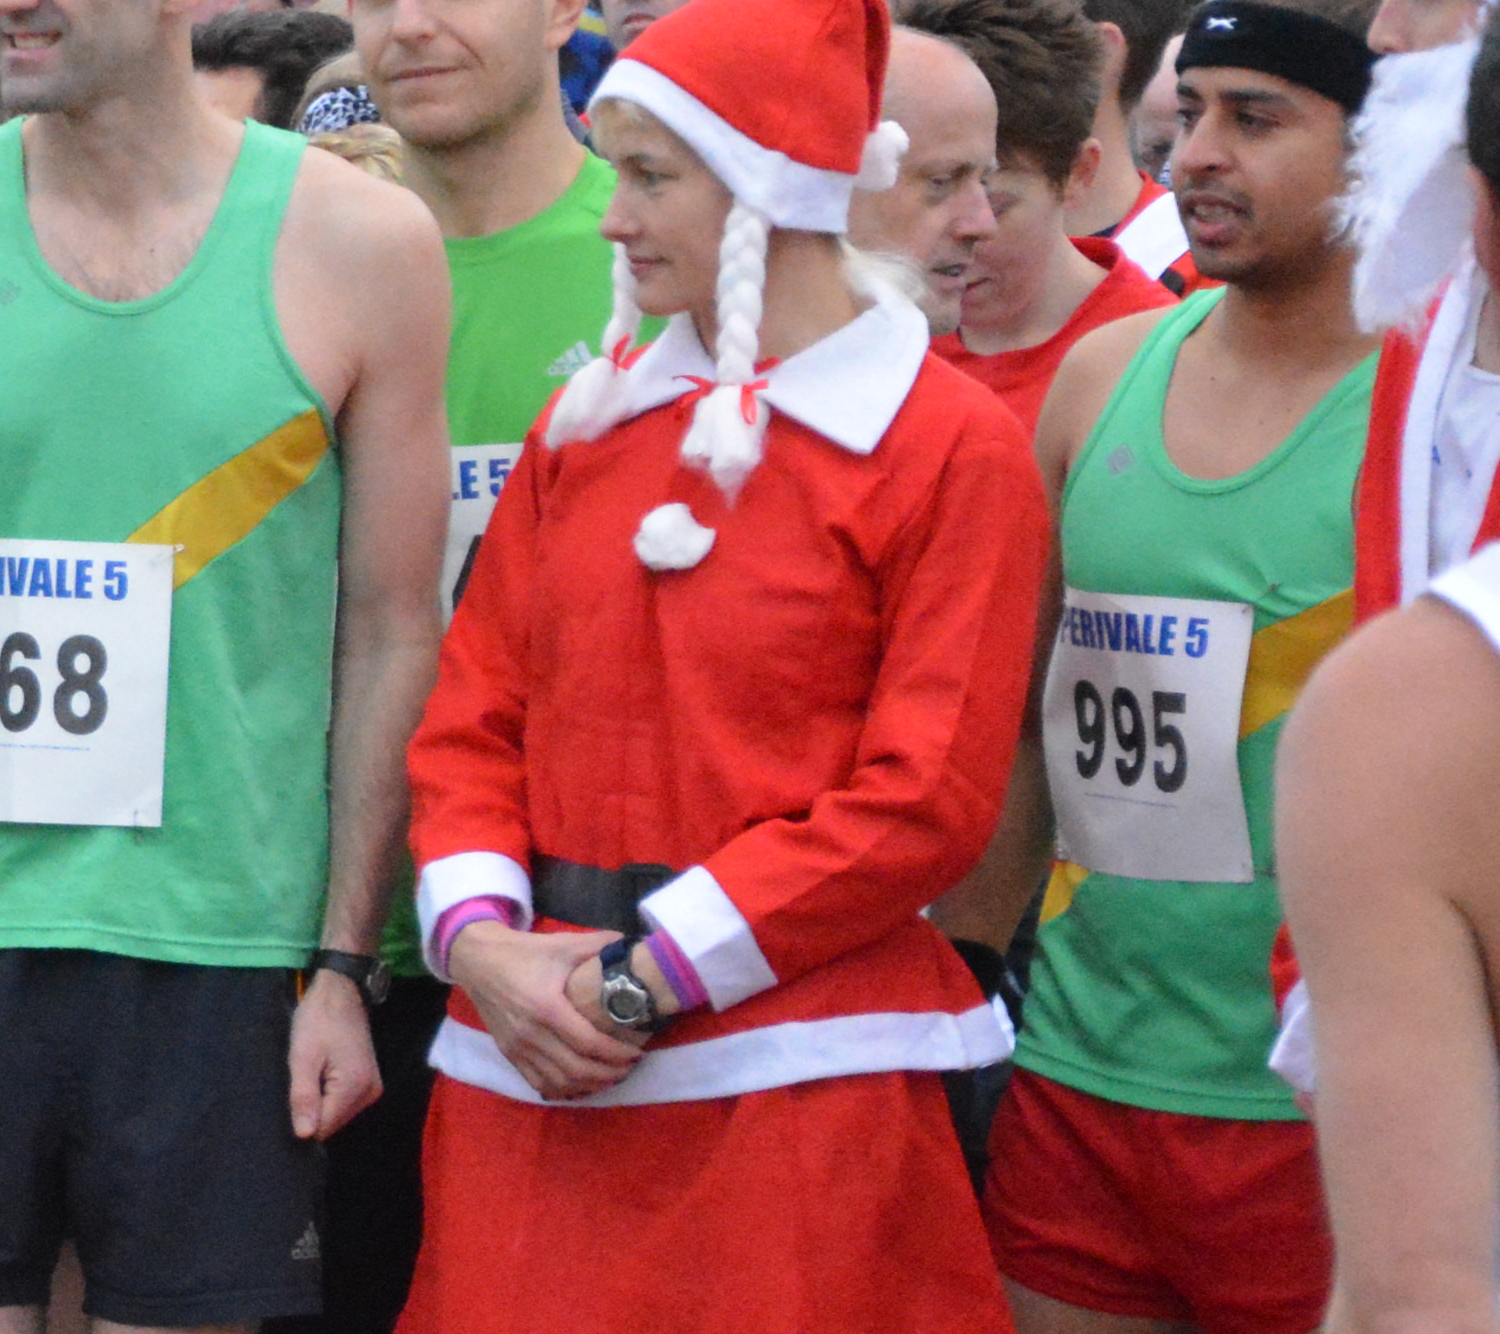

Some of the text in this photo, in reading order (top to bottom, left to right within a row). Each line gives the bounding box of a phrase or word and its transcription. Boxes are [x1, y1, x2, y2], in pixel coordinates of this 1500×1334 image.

[104, 560, 129, 601] 5
[1061, 606, 1209, 659] PERIVALE 5
[1073, 679, 1188, 794] 995
